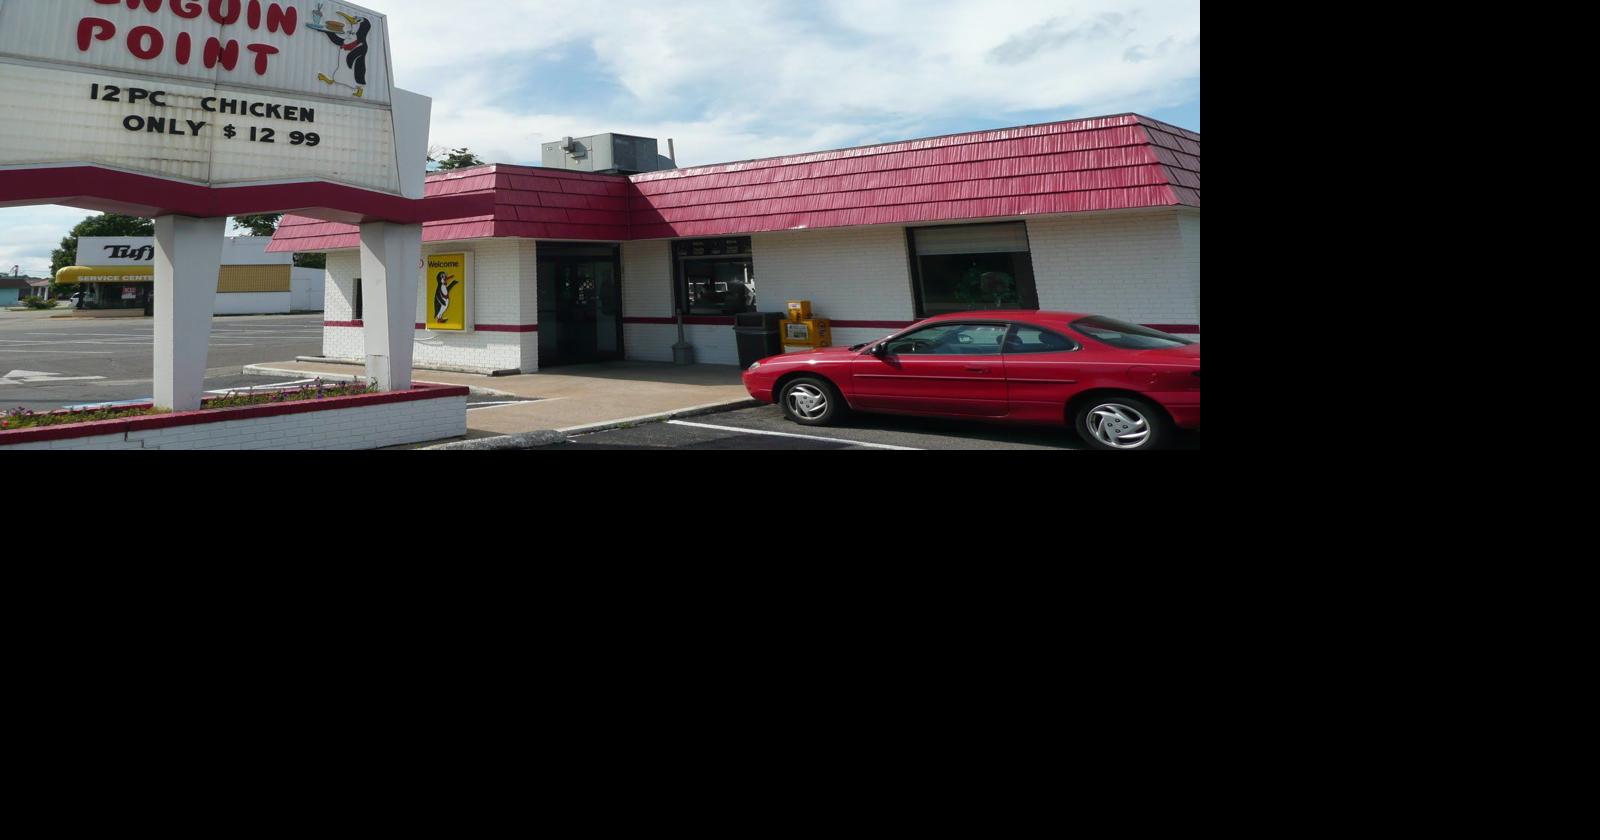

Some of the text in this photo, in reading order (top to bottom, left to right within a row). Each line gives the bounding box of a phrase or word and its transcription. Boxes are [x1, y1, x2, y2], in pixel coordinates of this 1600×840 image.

[93, 0, 298, 36] GUIN
[77, 17, 279, 75] POINT
[201, 96, 315, 122] CHICKEN
[122, 115, 207, 136] ONLY
[223, 123, 237, 139] $
[289, 131, 321, 147] 99
[428, 260, 459, 268] Welcome
